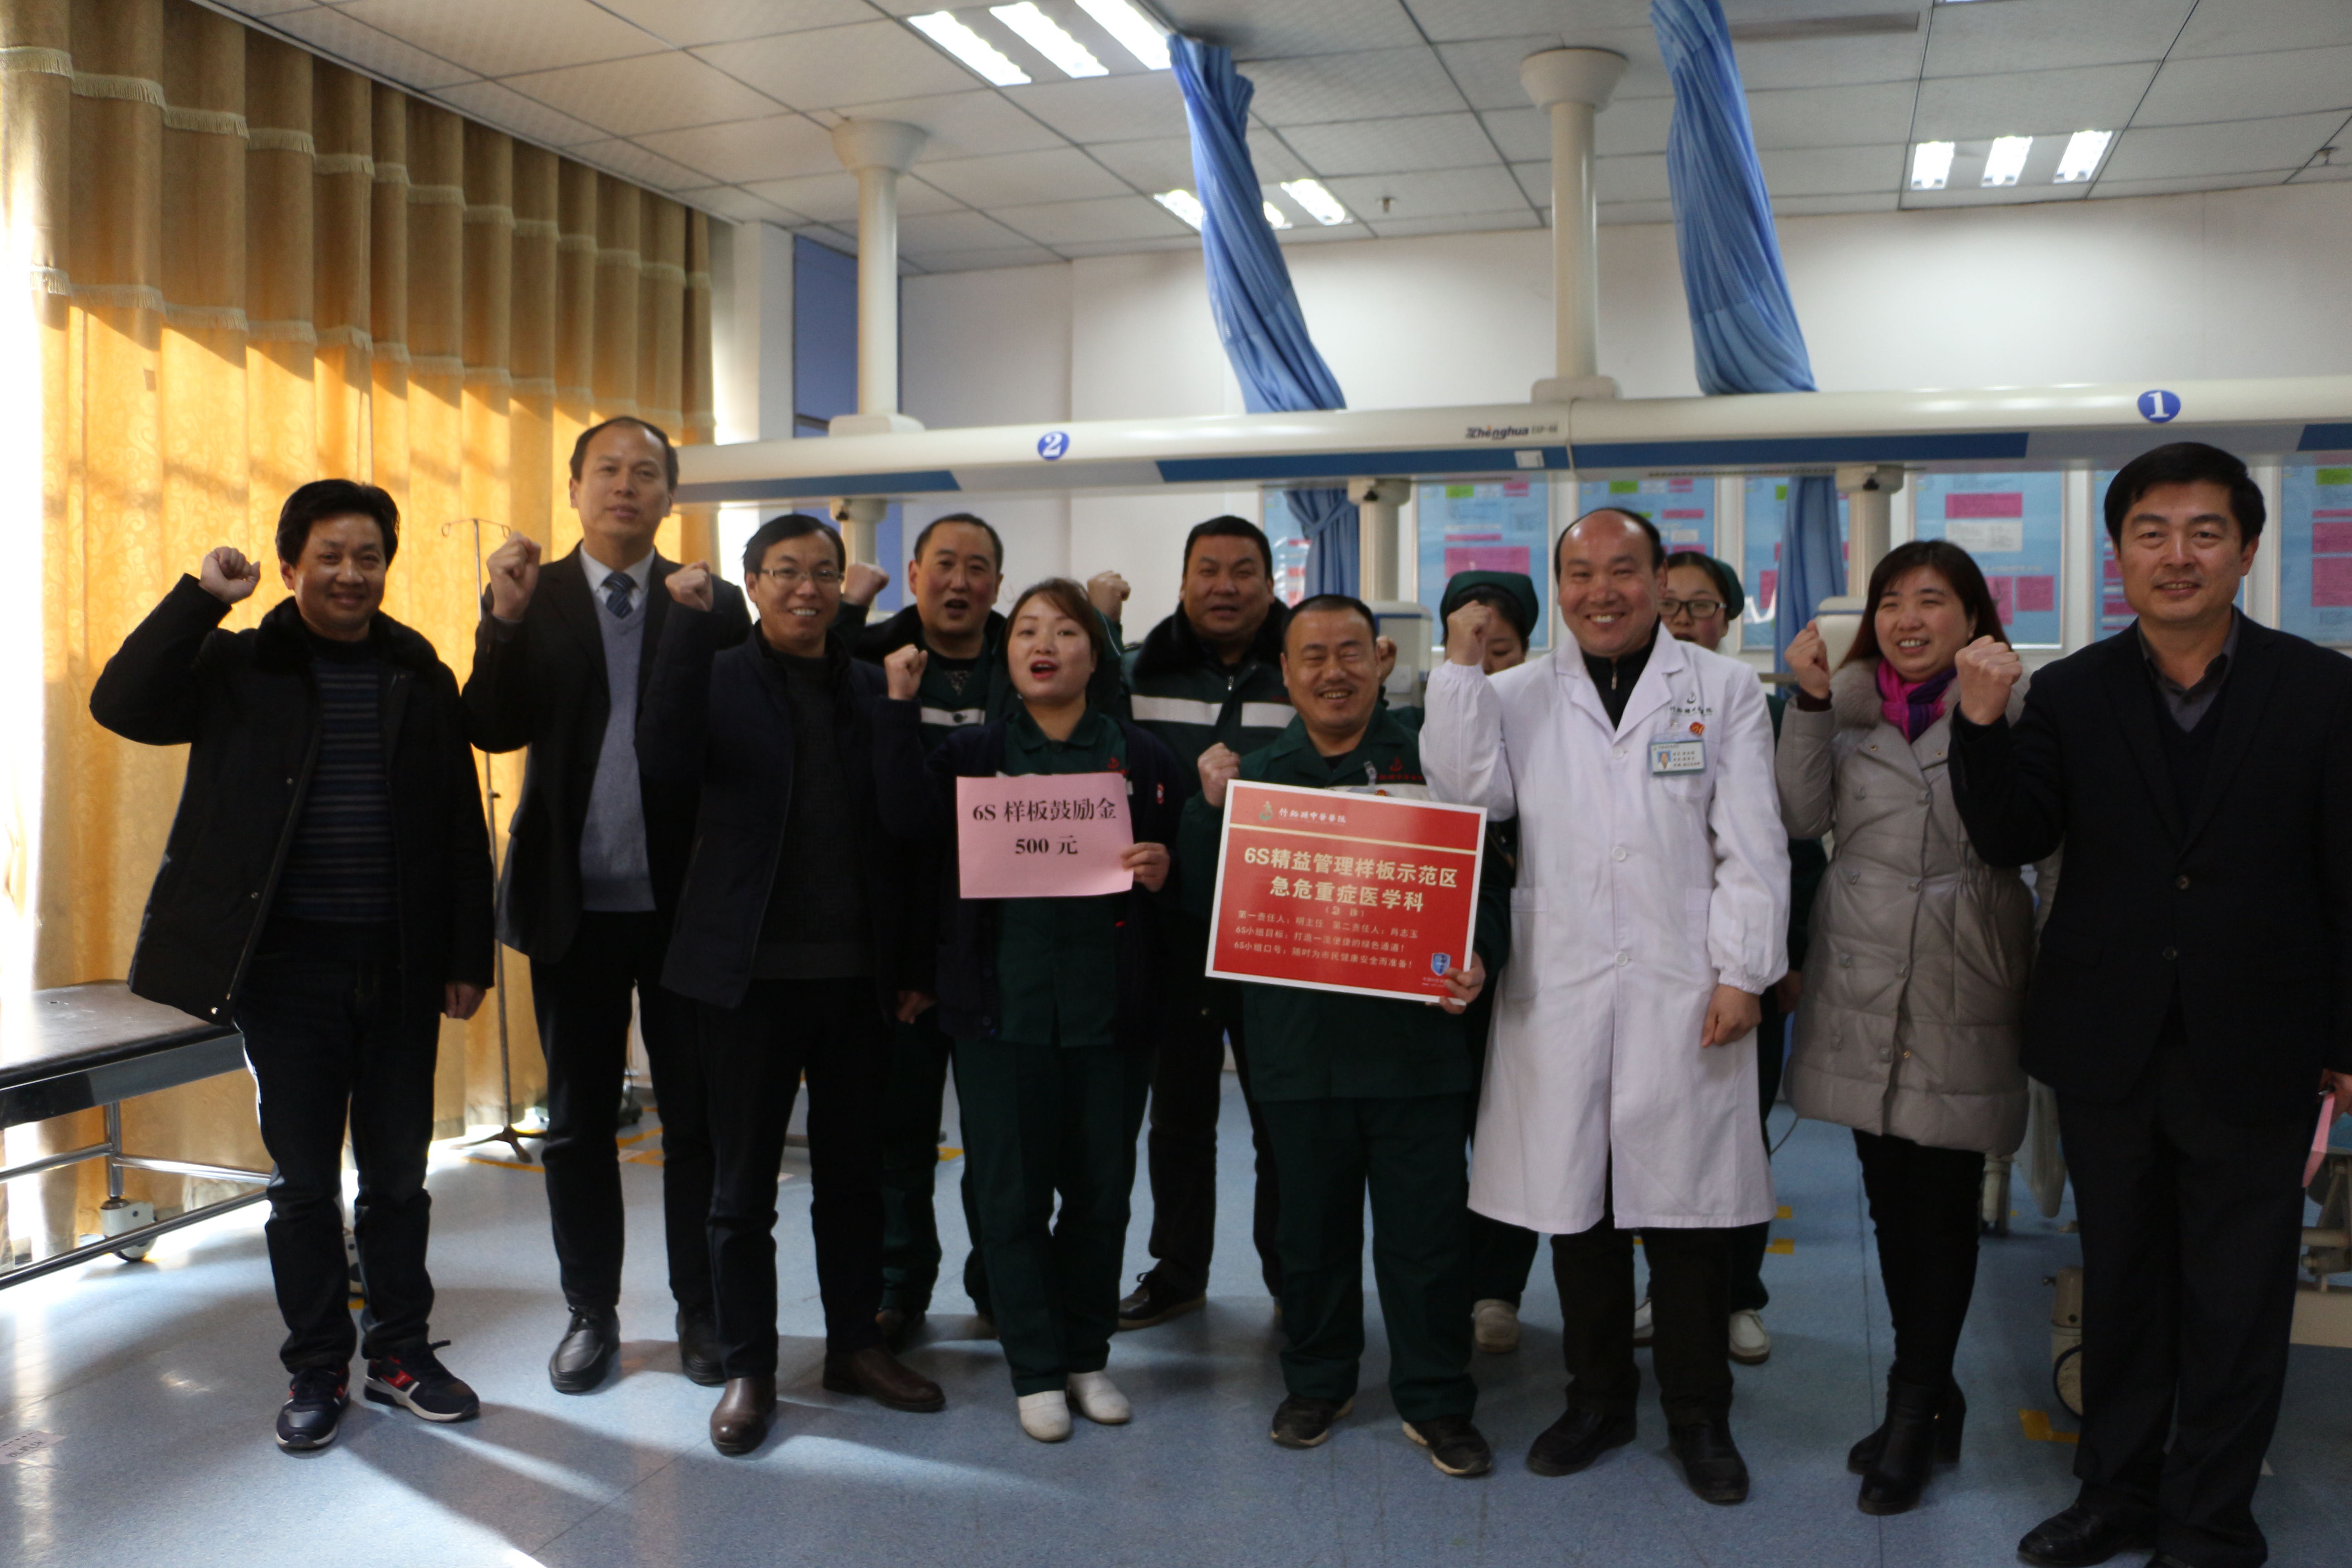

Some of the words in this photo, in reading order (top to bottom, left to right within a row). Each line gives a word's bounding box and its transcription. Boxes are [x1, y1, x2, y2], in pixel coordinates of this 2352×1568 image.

[2148, 392, 2170, 418] 1
[1043, 433, 1062, 456] 2
[973, 803, 996, 821] 6S
[1004, 798, 1117, 822] 样板鼓励金
[1015, 838, 1049, 855] 500
[1057, 835, 1078, 855] 元
[1244, 848, 1458, 888] 6S精益管理样板示范区
[1270, 876, 1424, 912] 急危重症医学科
